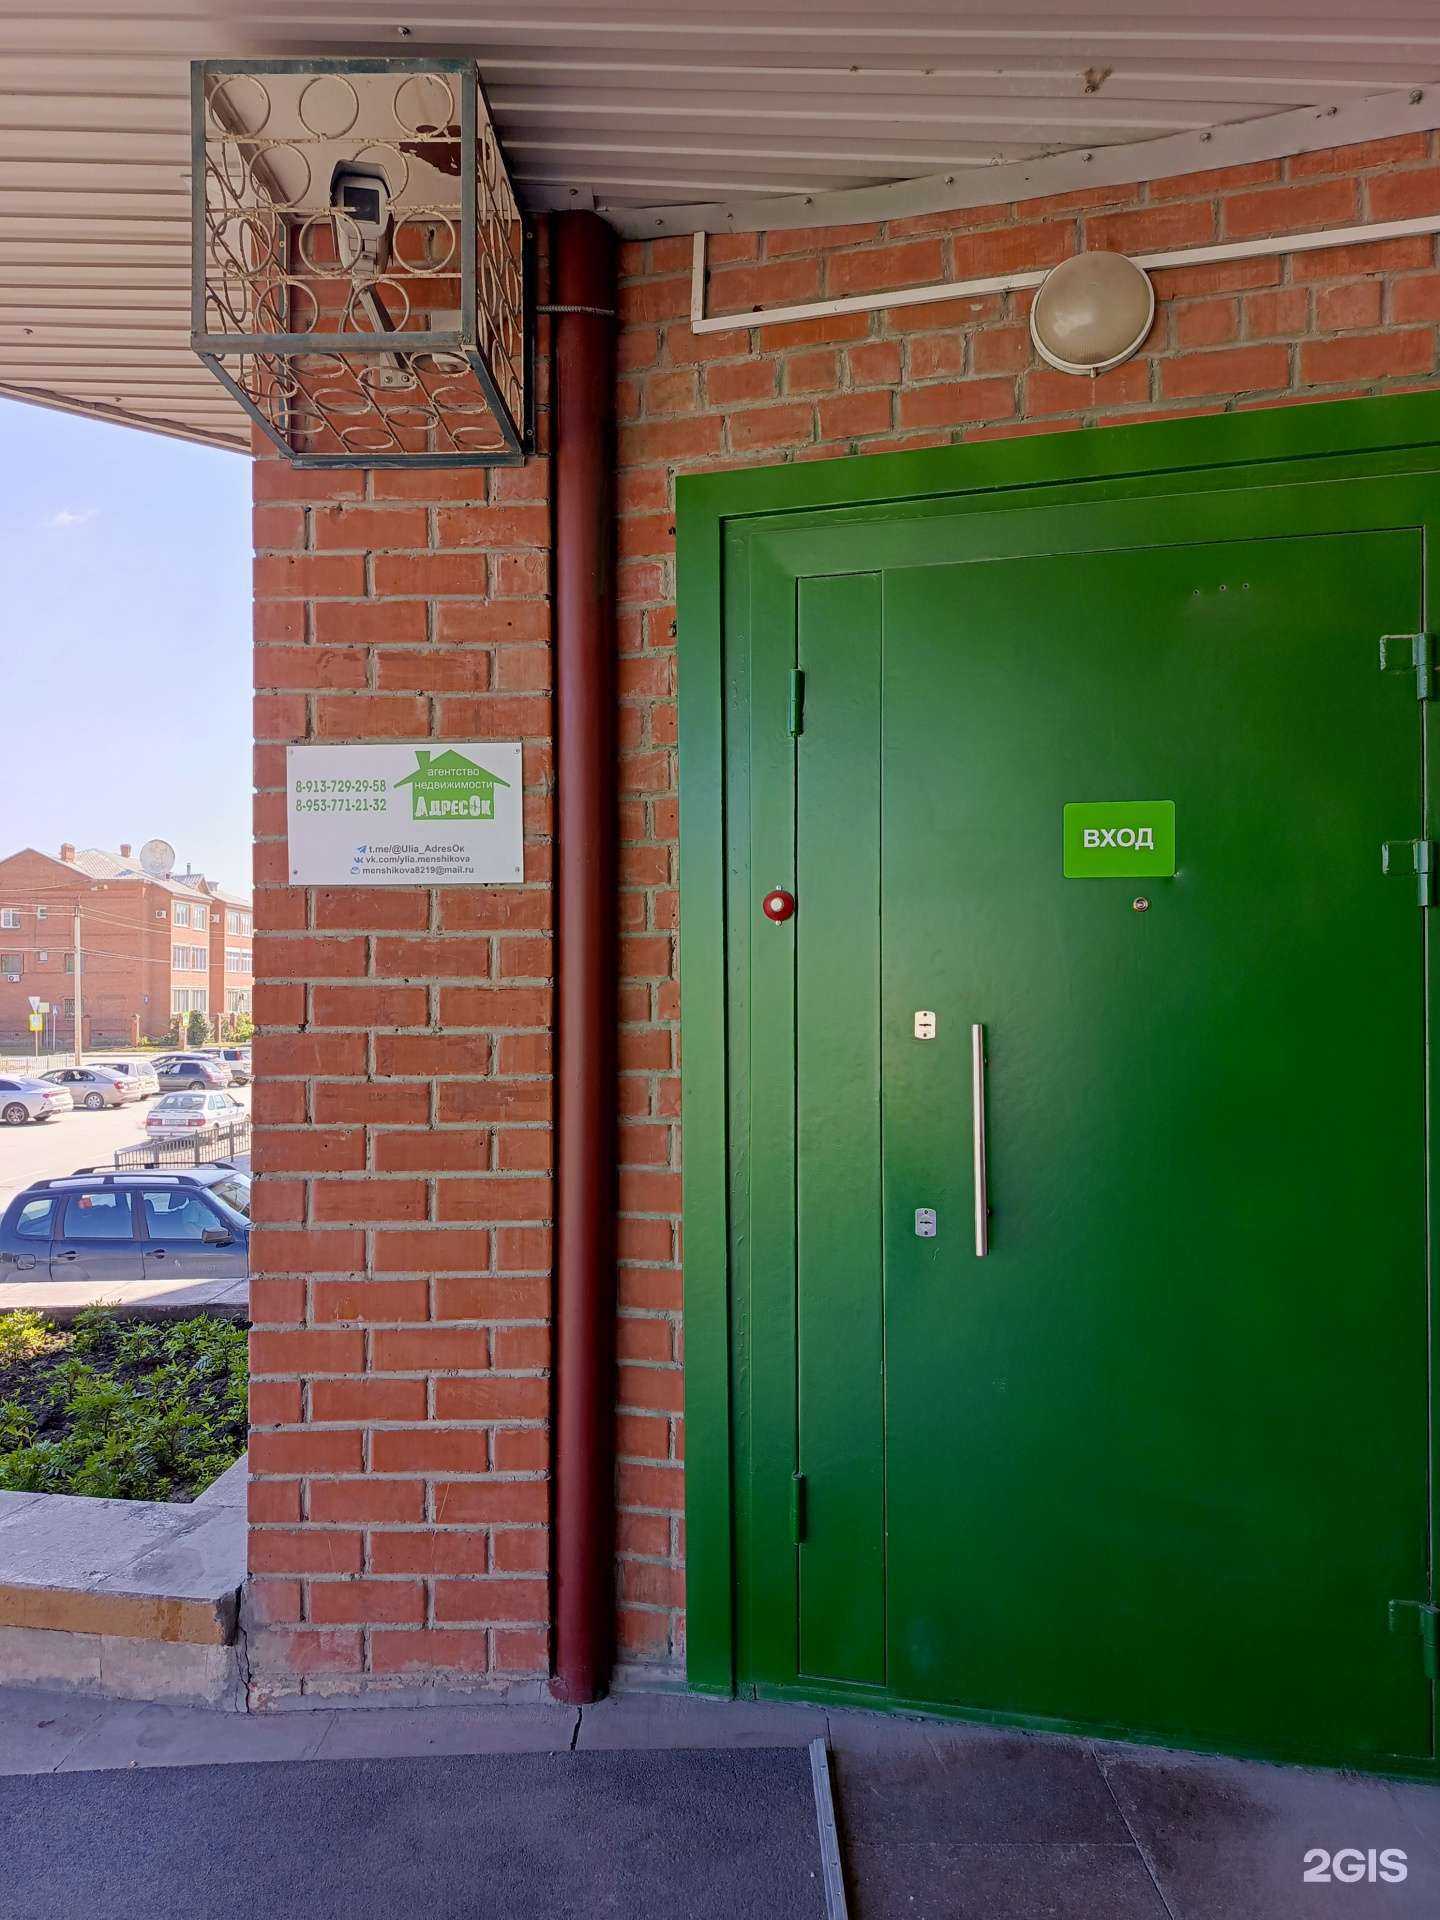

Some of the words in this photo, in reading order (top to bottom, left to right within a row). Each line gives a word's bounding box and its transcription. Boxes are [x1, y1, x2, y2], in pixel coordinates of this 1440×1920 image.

[427, 767, 480, 777] агентство
[296, 780, 387, 793] 8-913-729-29-58
[415, 780, 494, 791] недвижимости
[296, 798, 387, 812] 8-953-771-21-32
[1083, 827, 1155, 851] ВХОД
